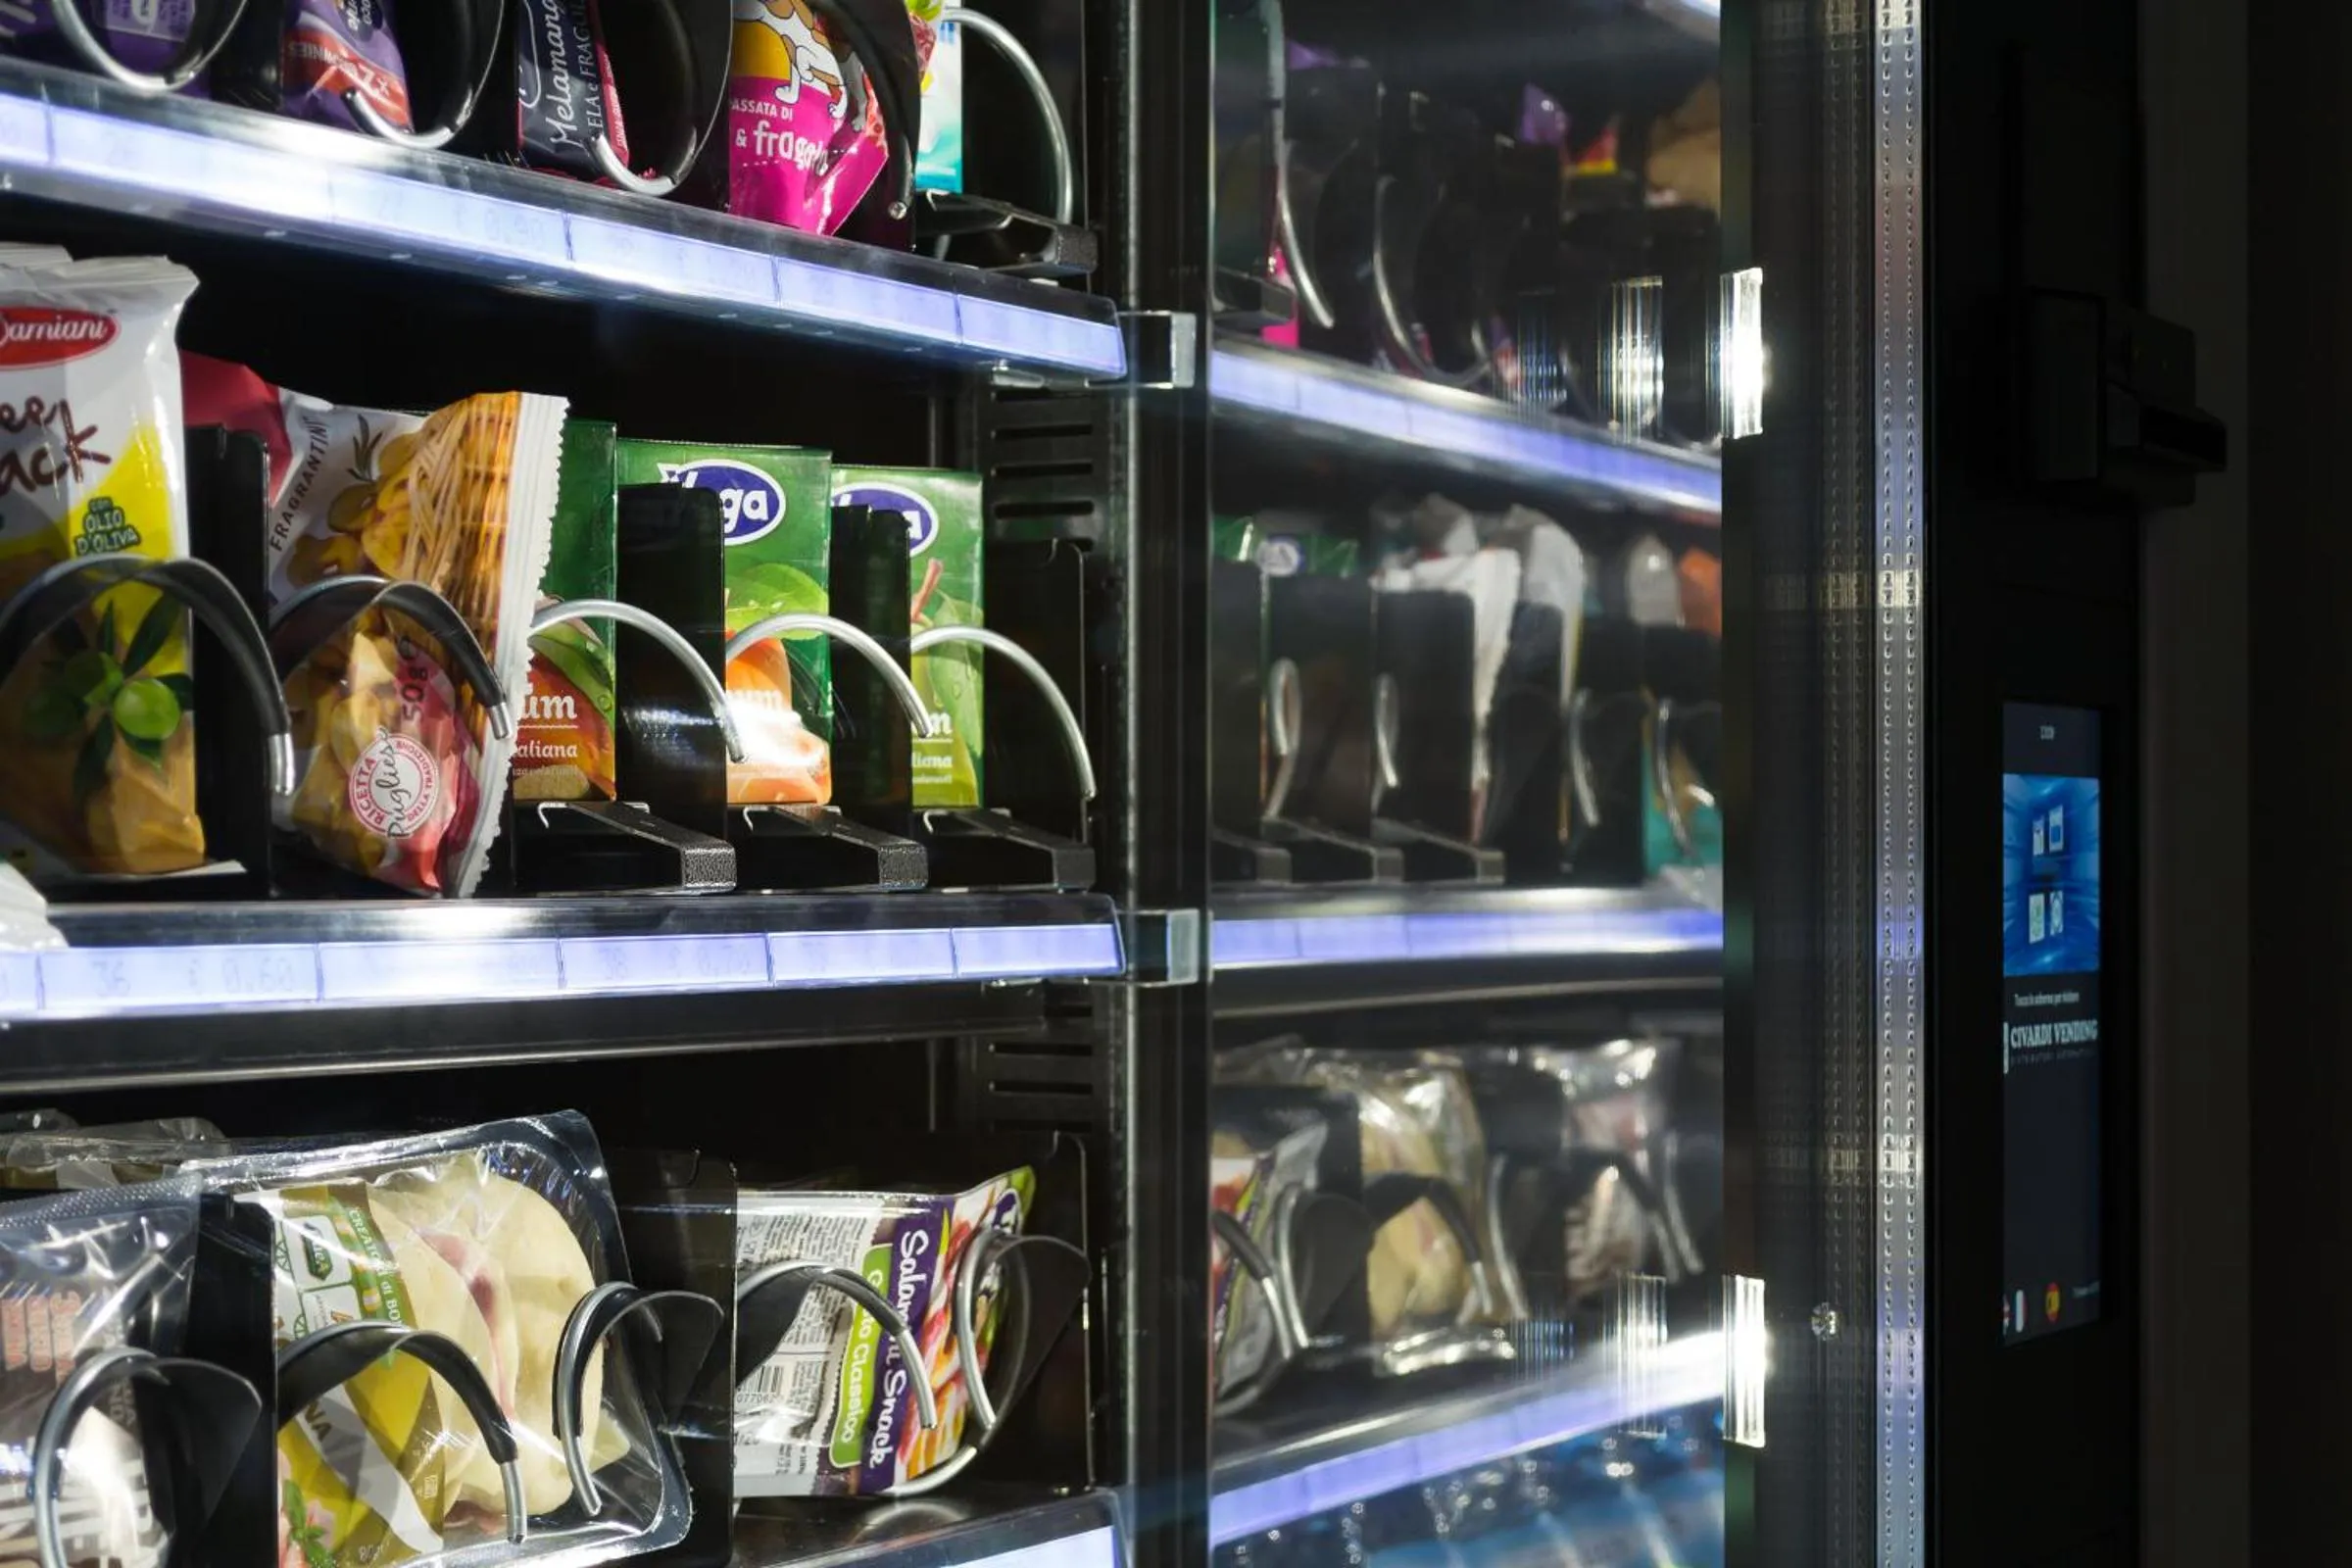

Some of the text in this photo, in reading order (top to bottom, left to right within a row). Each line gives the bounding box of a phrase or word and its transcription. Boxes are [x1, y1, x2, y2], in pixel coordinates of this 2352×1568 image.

[729, 97, 794, 122] ASSATA DI
[85, 509, 122, 534] OLIO
[355, 757, 386, 826] RICETTA
[2010, 1018, 2098, 1049] CIVARDI VENDING
[840, 1343, 870, 1444] Classico
[868, 1369, 907, 1469] Snack
